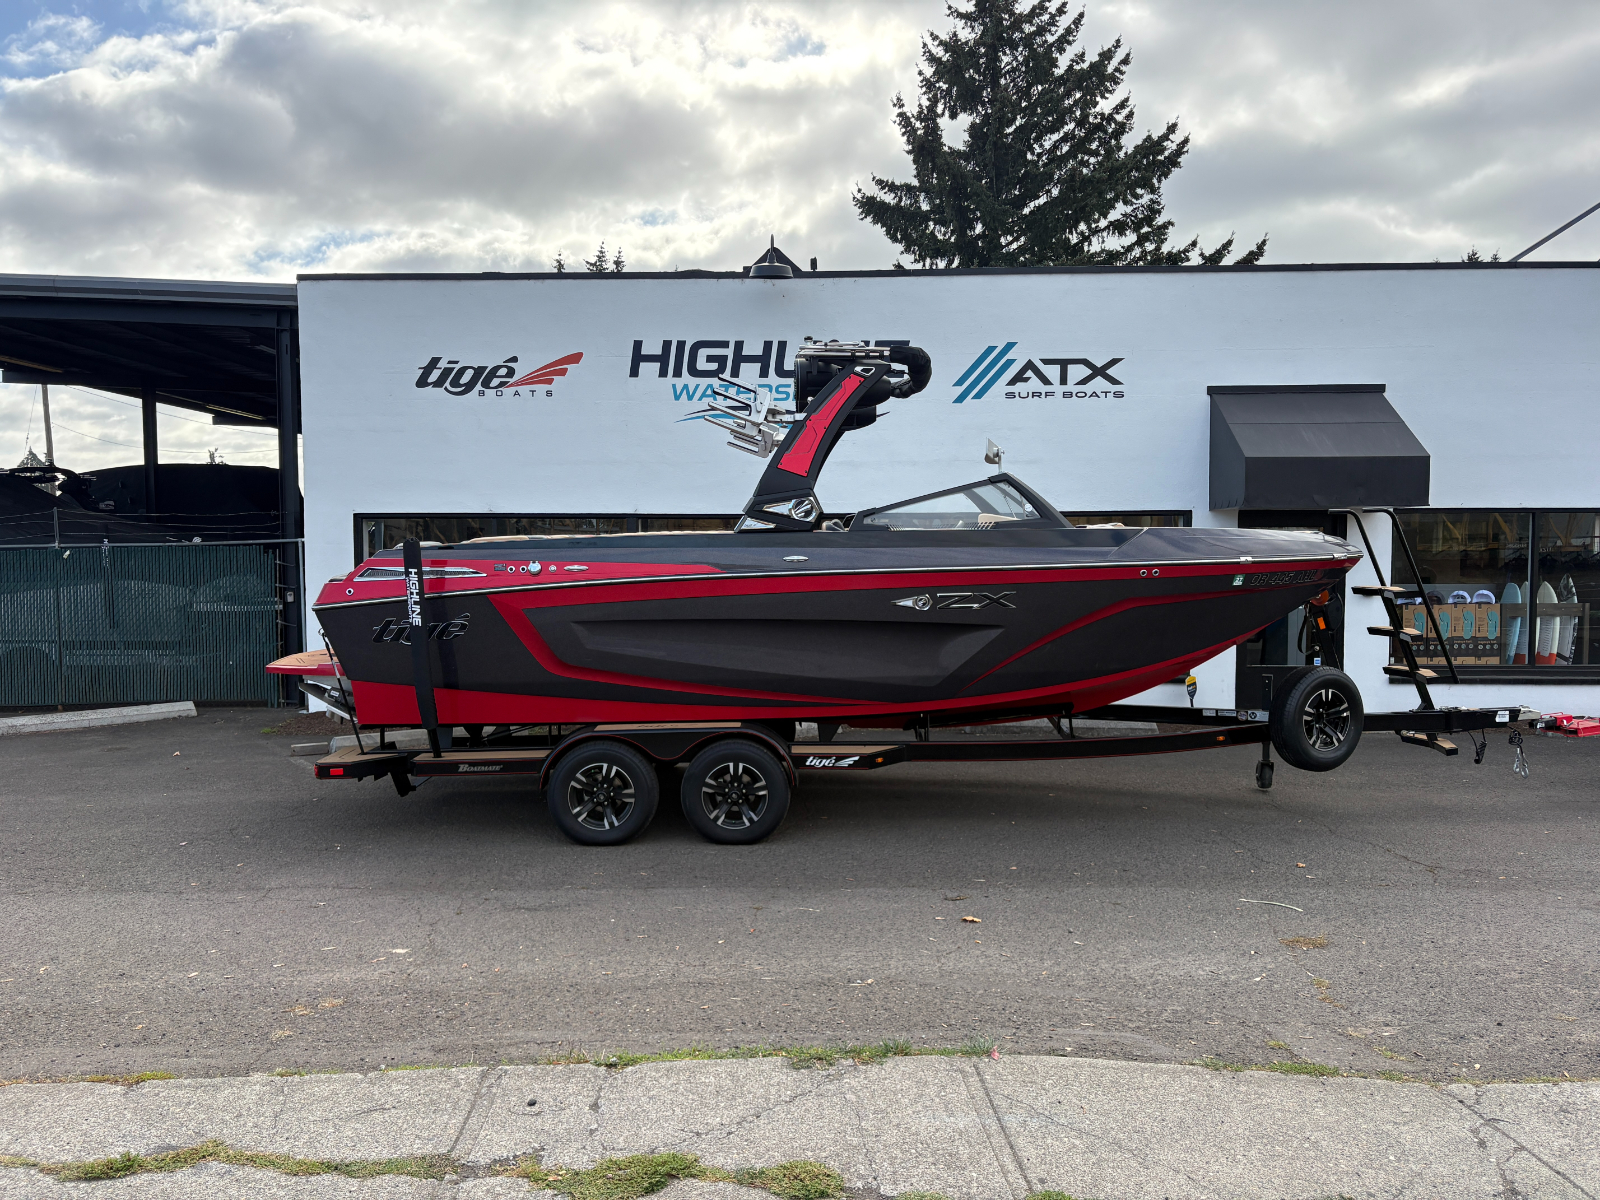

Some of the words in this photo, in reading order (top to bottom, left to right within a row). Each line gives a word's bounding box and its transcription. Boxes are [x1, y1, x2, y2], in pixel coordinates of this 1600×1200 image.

[628, 339, 910, 379] HIGHL
[414, 355, 519, 396] tigé
[1004, 357, 1126, 386] ATX
[478, 389, 553, 397] BOATS
[1004, 391, 1056, 399] SURF
[1062, 390, 1126, 399] BOATS
[408, 568, 422, 627] HIGHLINE
[936, 590, 1017, 610] ZX
[805, 755, 837, 768] tigé
